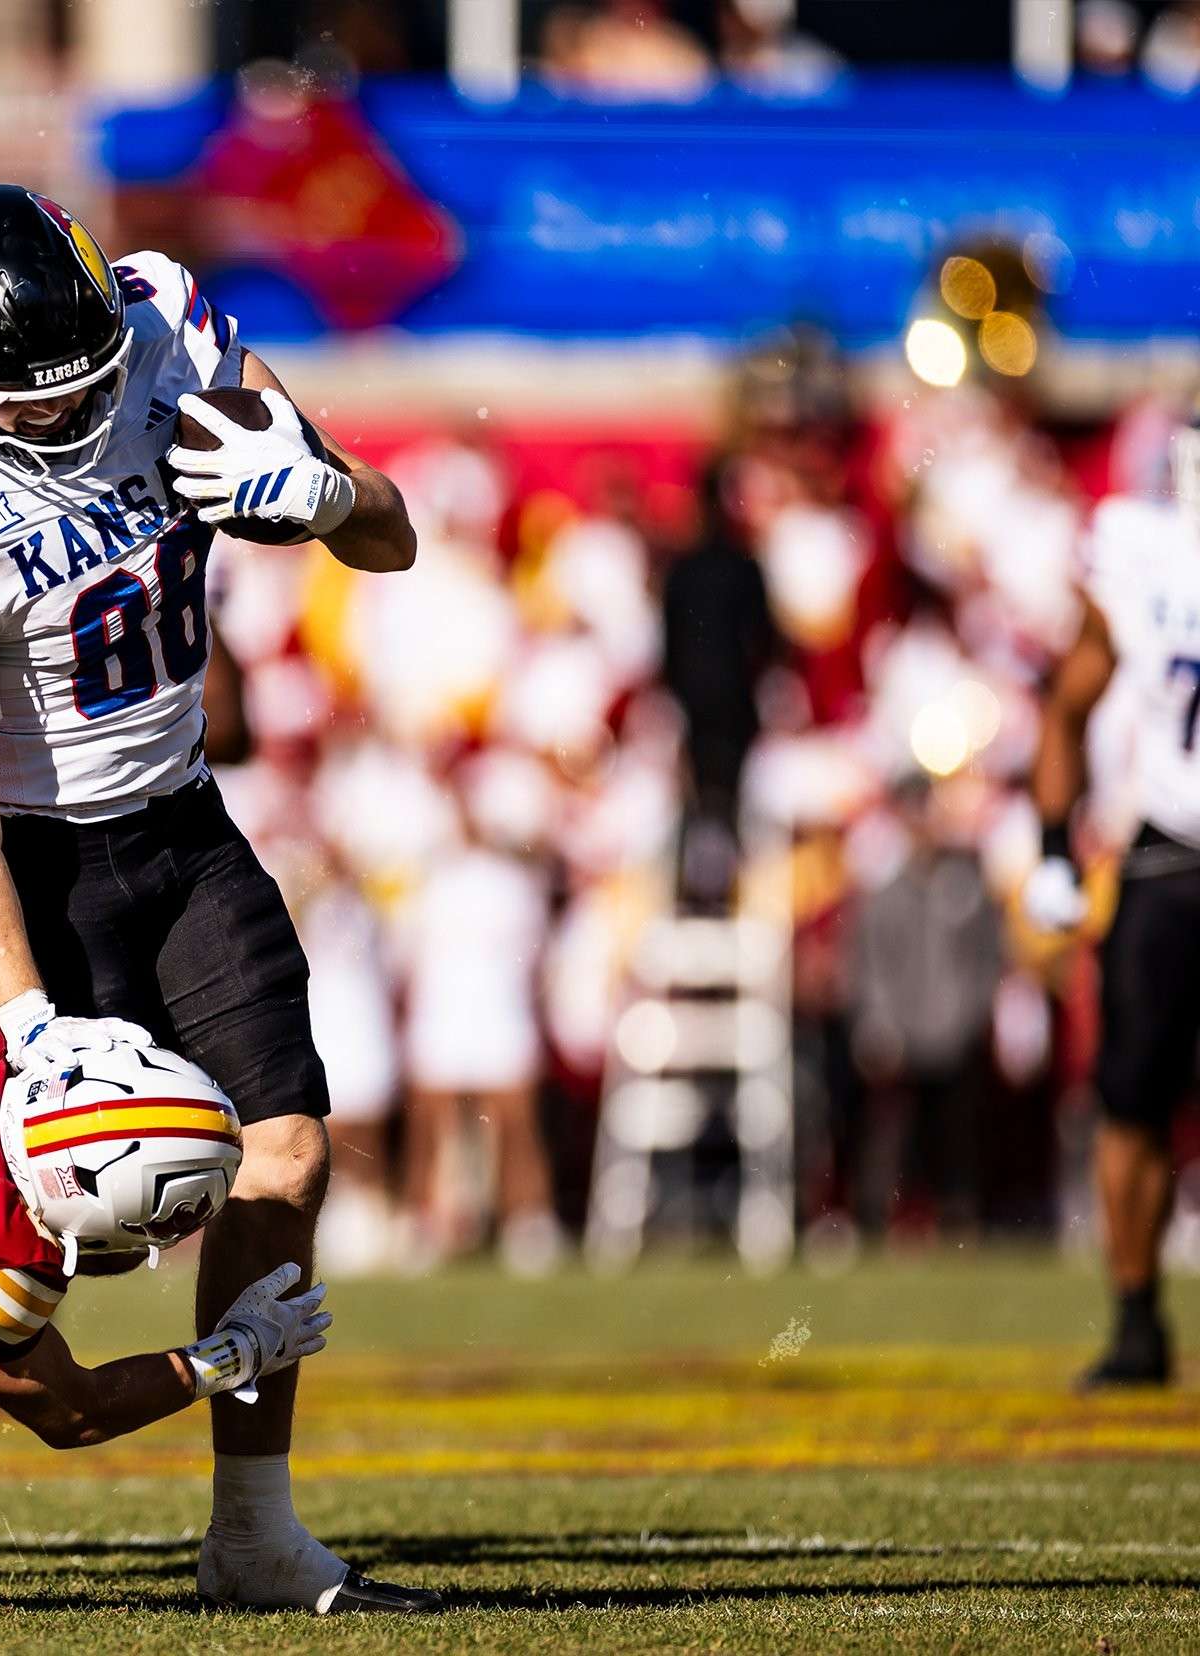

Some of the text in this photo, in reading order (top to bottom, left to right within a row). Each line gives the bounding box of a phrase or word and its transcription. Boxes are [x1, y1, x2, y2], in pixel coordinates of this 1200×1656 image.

[33, 356, 90, 386] KANSAS
[7, 455, 188, 600] KANS
[306, 473, 321, 510] ADIZERO
[69, 517, 210, 721] 88
